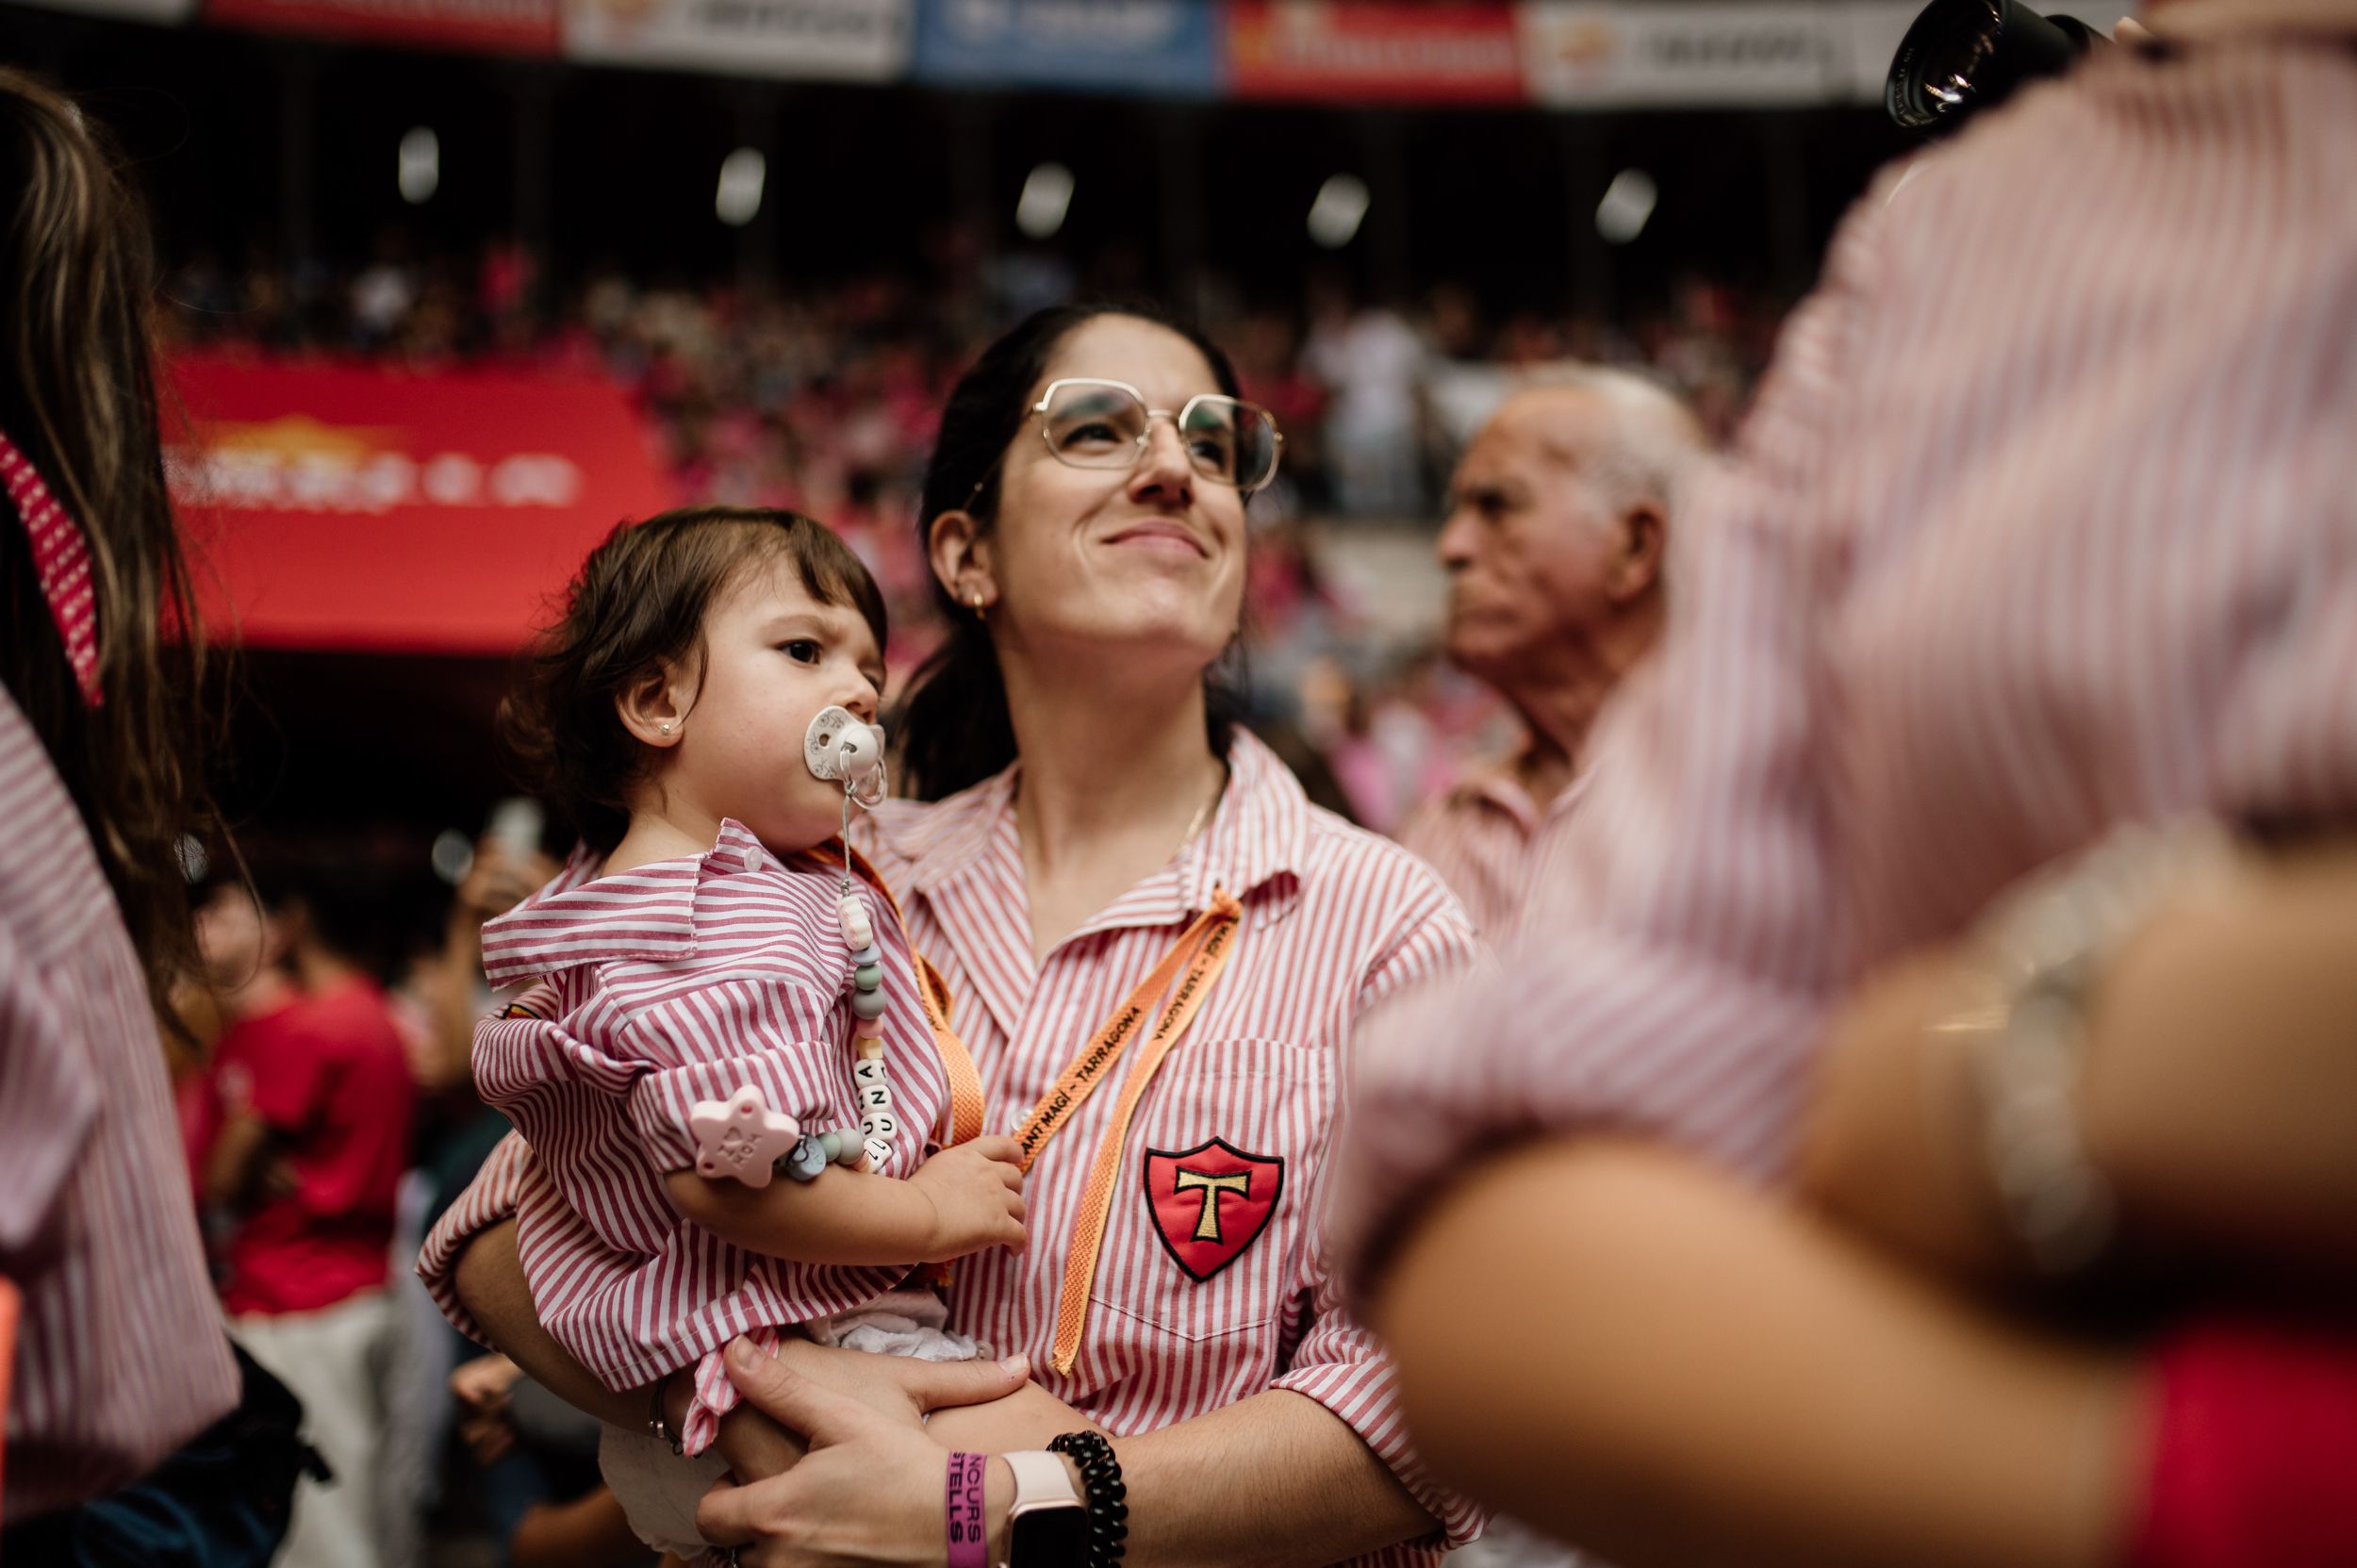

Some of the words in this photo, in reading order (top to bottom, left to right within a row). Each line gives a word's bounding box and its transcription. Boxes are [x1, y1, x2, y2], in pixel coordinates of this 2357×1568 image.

[1152, 968, 1205, 1041] TARRAGONA
[1021, 1123, 1044, 1155] ANT
[1075, 1005, 1141, 1082] TARRAGONA
[948, 1452, 965, 1543] STELLS
[966, 1455, 982, 1543] NCURS
